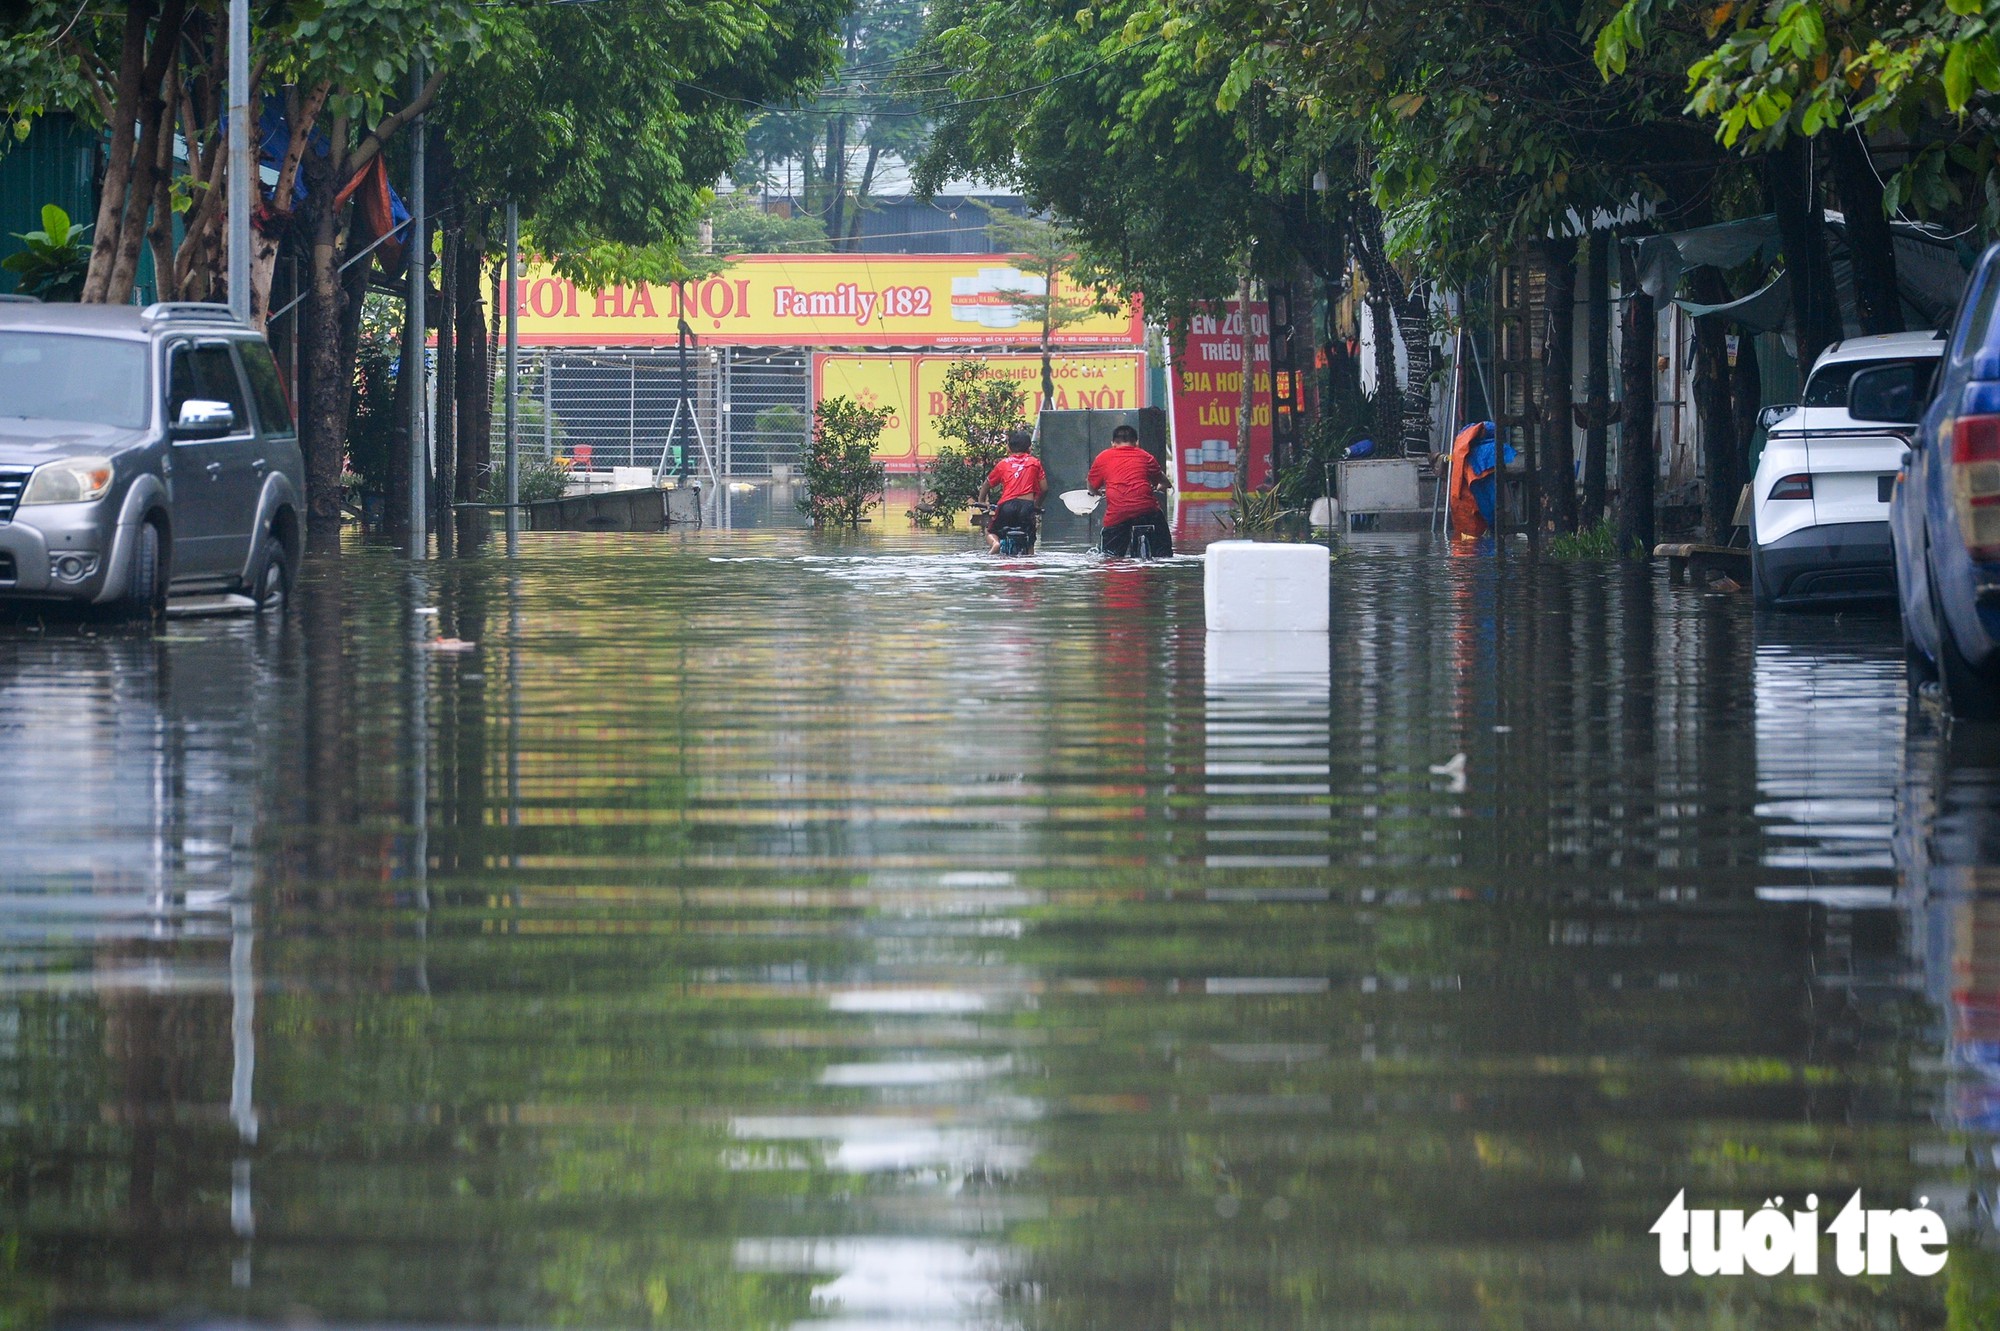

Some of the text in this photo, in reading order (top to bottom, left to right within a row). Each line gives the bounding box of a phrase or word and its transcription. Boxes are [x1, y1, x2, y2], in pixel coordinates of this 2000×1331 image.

[667, 272, 751, 329] NỘI
[774, 283, 931, 326] Family 182
[1200, 338, 1240, 361] TRIỀU
[1008, 366, 1037, 381] HIỆU
[1041, 363, 1079, 379] UỐC
[1182, 372, 1212, 392] BIA
[1199, 398, 1231, 426] LẨU
